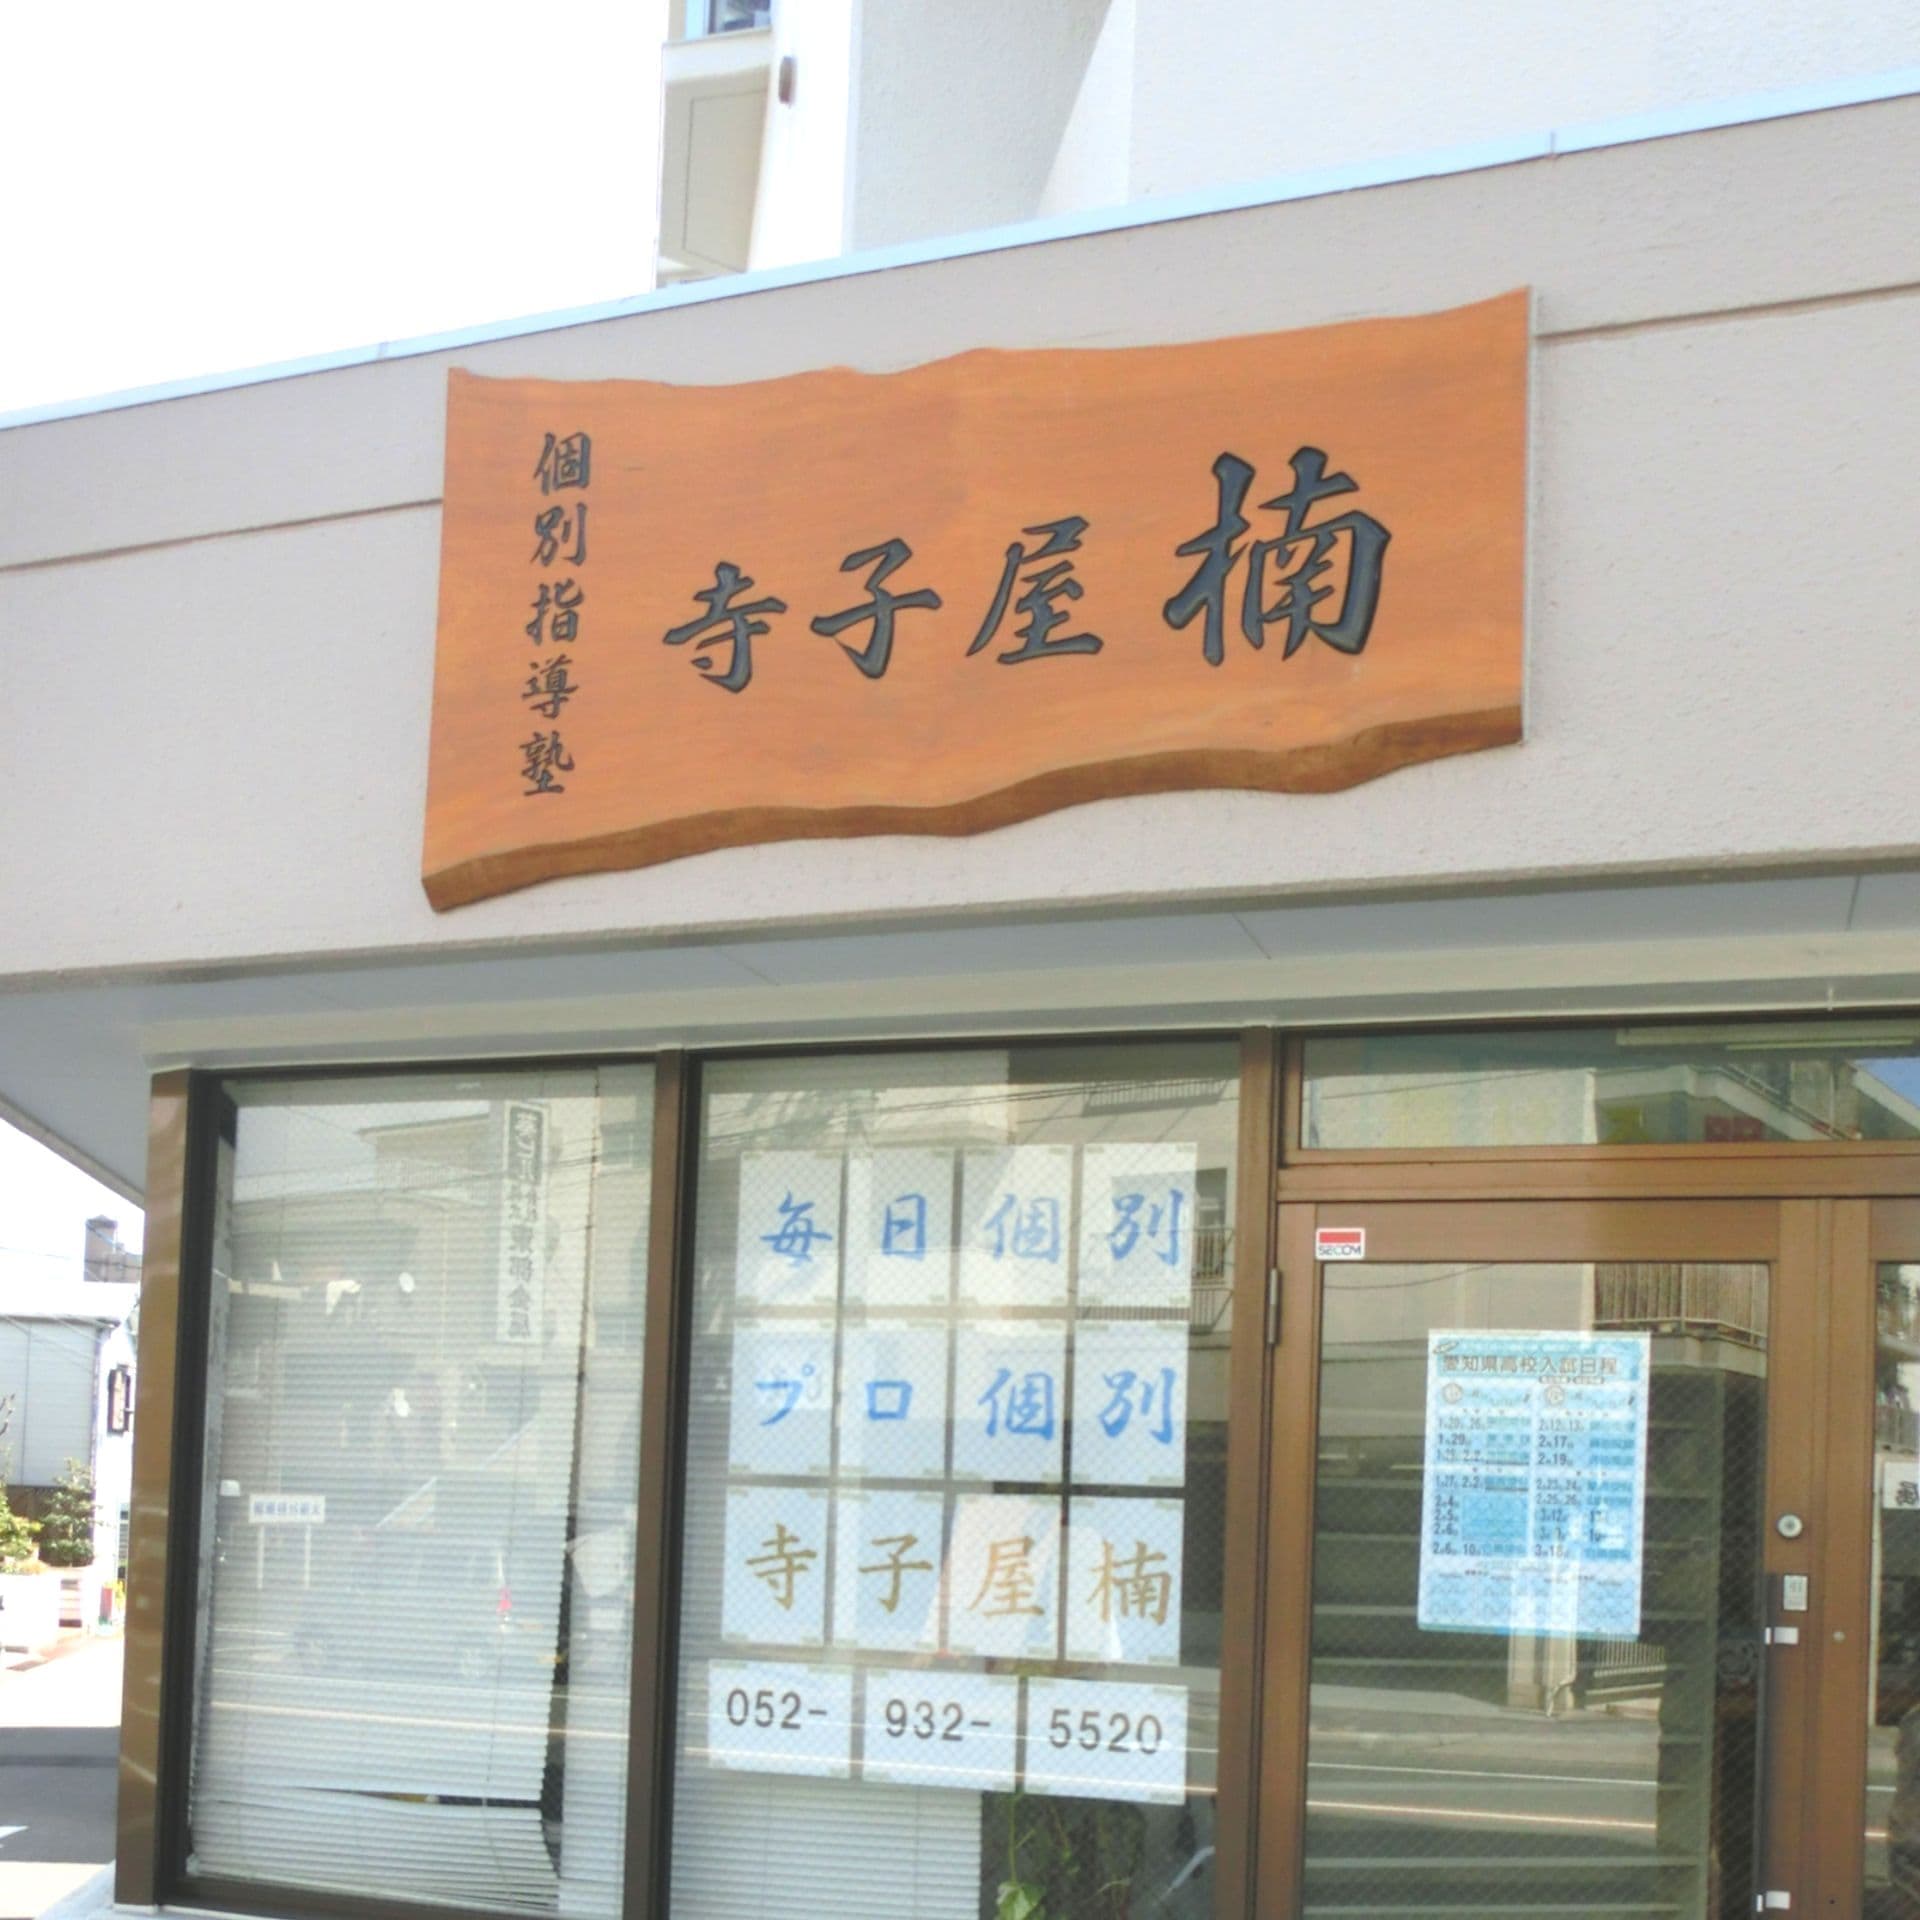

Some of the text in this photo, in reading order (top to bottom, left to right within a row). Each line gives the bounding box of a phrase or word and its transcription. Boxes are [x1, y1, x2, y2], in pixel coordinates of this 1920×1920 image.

[662, 446, 1391, 693] 寺子屋楠
[519, 431, 590, 797] 個別指導塾
[760, 1189, 1186, 1268] 毎日個別
[1319, 1245, 1361, 1256] SECOM
[755, 1363, 1177, 1445] プロ個別
[746, 1523, 1173, 1625] 寺子屋楠
[725, 1688, 1163, 1756] 052- 932- 5520
